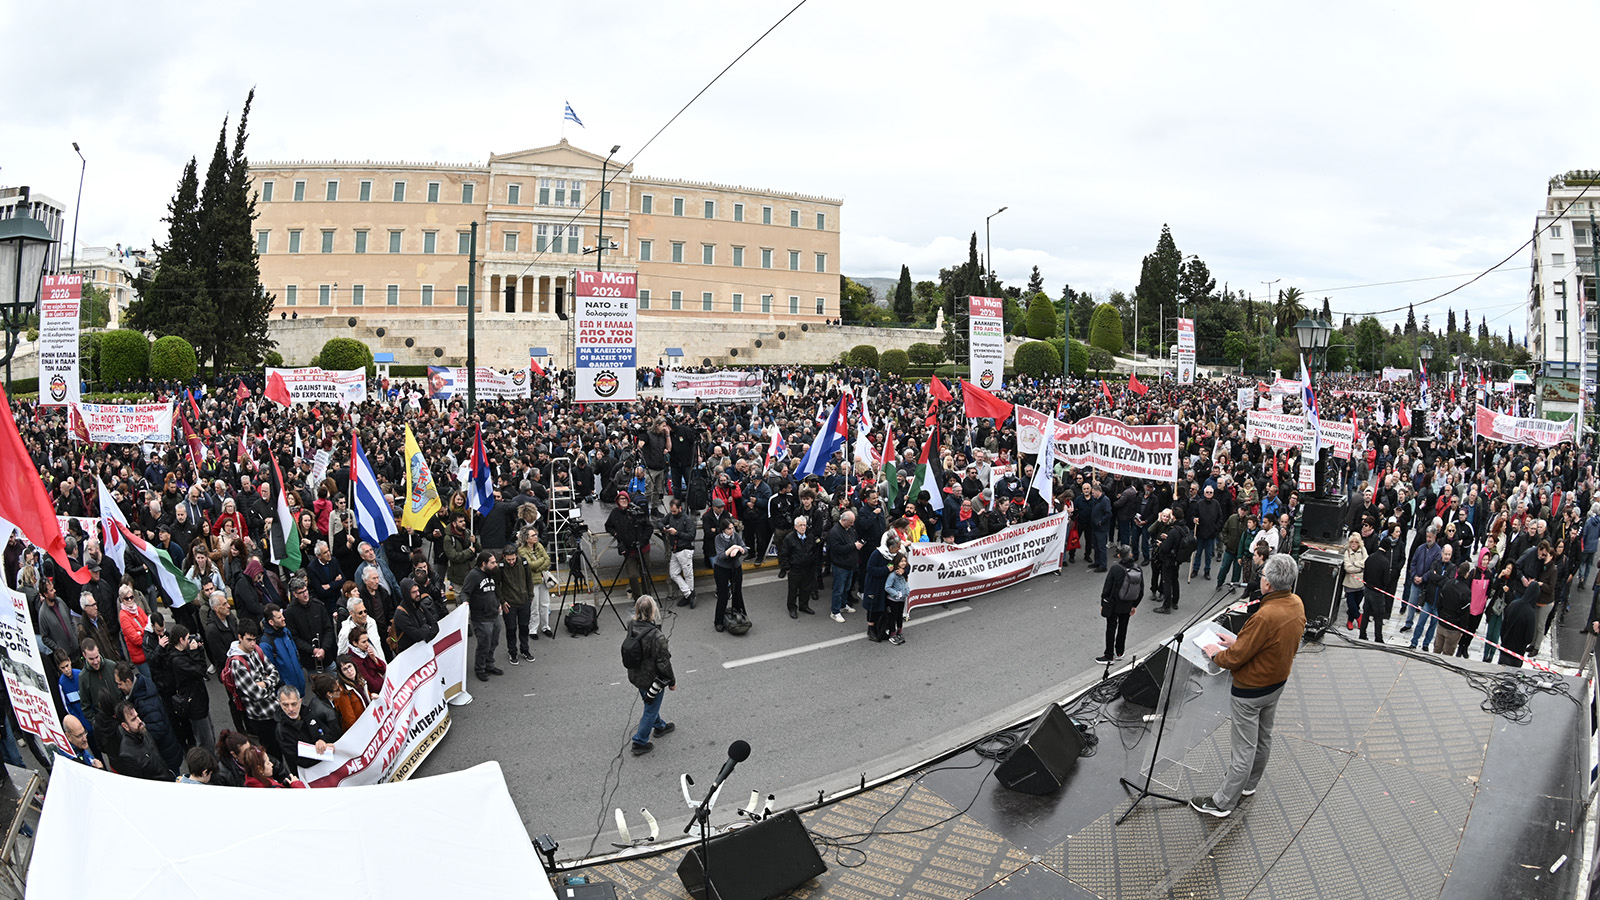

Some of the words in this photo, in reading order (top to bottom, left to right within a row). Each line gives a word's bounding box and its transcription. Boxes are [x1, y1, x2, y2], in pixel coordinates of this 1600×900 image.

[50, 288, 70, 299] 2026
[592, 287, 621, 297] 2026
[135, 405, 168, 413] ΚΑΙΣΑΡΙΑΝΗ
[1249, 412, 1273, 420] ΤΙΜΟΥΜΕ
[91, 413, 99, 422] ΤΗ
[101, 415, 121, 423] ΦΛΟΓΑ
[122, 415, 134, 423] ΤΟΥ
[135, 415, 154, 423] ΑΓΩΝΑ
[1096, 422, 1172, 443] ΠΡΩΤΟΜΑΓΙΑ
[1248, 420, 1277, 429] ΒΑΔΙΖΟΥΜΕ
[1286, 424, 1304, 432] ΔΡΟΜΟ
[1321, 421, 1352, 431] ΚΑΙΣΑΡΙΑΝΗ
[1254, 428, 1271, 437] ΖΗΤΩ
[1278, 431, 1304, 442] ΚΟΚΚΙΝ
[1325, 431, 1351, 440] ΑΝΑΤΡΟΠΗ
[1070, 441, 1091, 455] ΜΑΣ
[1100, 443, 1109, 456] ΤΑ
[1111, 446, 1145, 462] ΚΕΡΔΗ
[1147, 452, 1172, 466] ΤΟΥΣ
[1116, 462, 1146, 474] ΤΡΟΦΙΜΩΝ
[1152, 468, 1173, 478] ΠΟΤΩΝ
[412, 462, 429, 503] WFTU
[912, 545, 945, 557] WORKING
[1027, 517, 1064, 532] SOLIDARITY
[911, 562, 935, 572] FOR
[937, 561, 946, 570] A
[949, 554, 978, 570] SOCIETY
[981, 544, 1020, 561] WITHOUT
[1024, 533, 1058, 549] POVERTY,
[938, 568, 967, 580] WARS
[970, 564, 986, 576] AND
[988, 546, 1047, 569] EXPLOITATION
[932, 590, 950, 598] METRO
[952, 588, 963, 596] RAIL
[964, 584, 986, 593] WORKERS
[346, 755, 363, 776] ΜΕ
[363, 737, 384, 764] ΤΟΥΣ
[392, 687, 411, 713] ΤΩΝ
[410, 660, 437, 691] ΛΑΩΝ
[397, 740, 431, 782] ΜΟΥΣΙΚΟΣ
